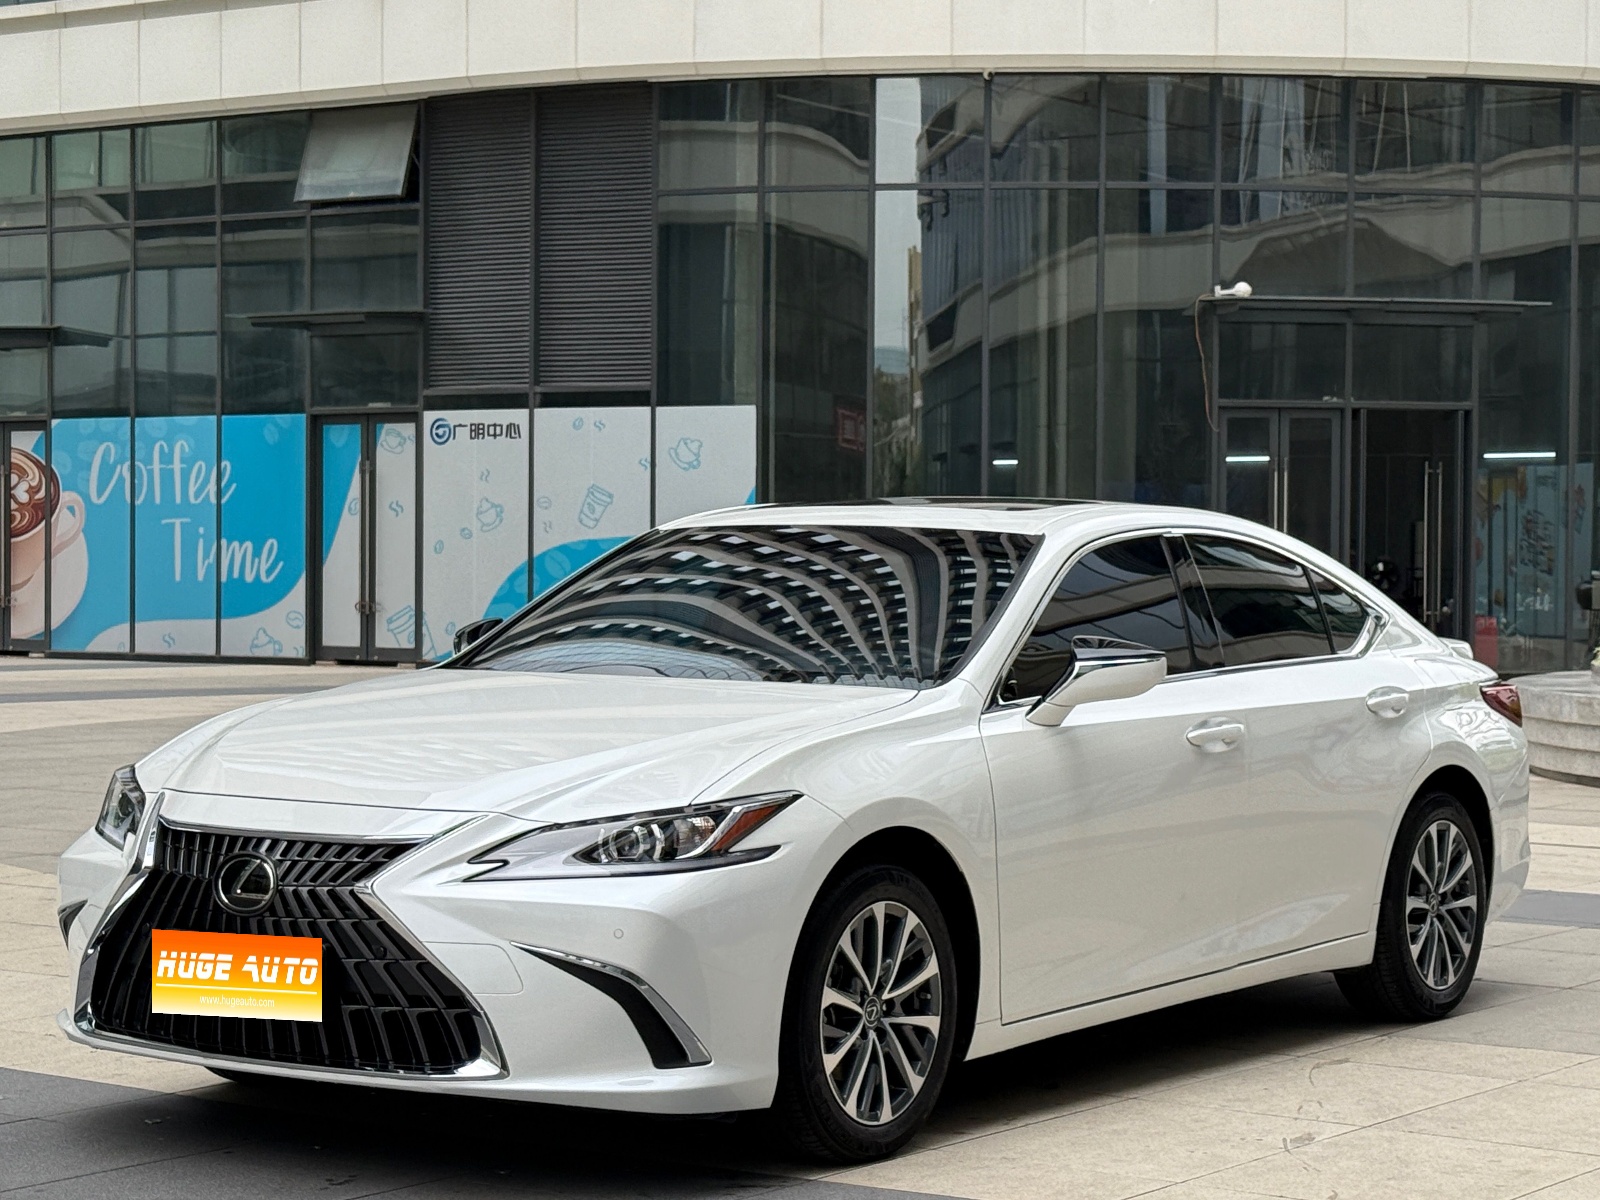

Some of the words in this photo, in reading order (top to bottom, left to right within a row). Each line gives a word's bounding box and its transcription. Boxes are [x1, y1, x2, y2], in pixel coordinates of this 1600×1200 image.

[452, 422, 522, 440] 广明中心
[88, 439, 237, 505] Coffee
[161, 517, 284, 583] Time
